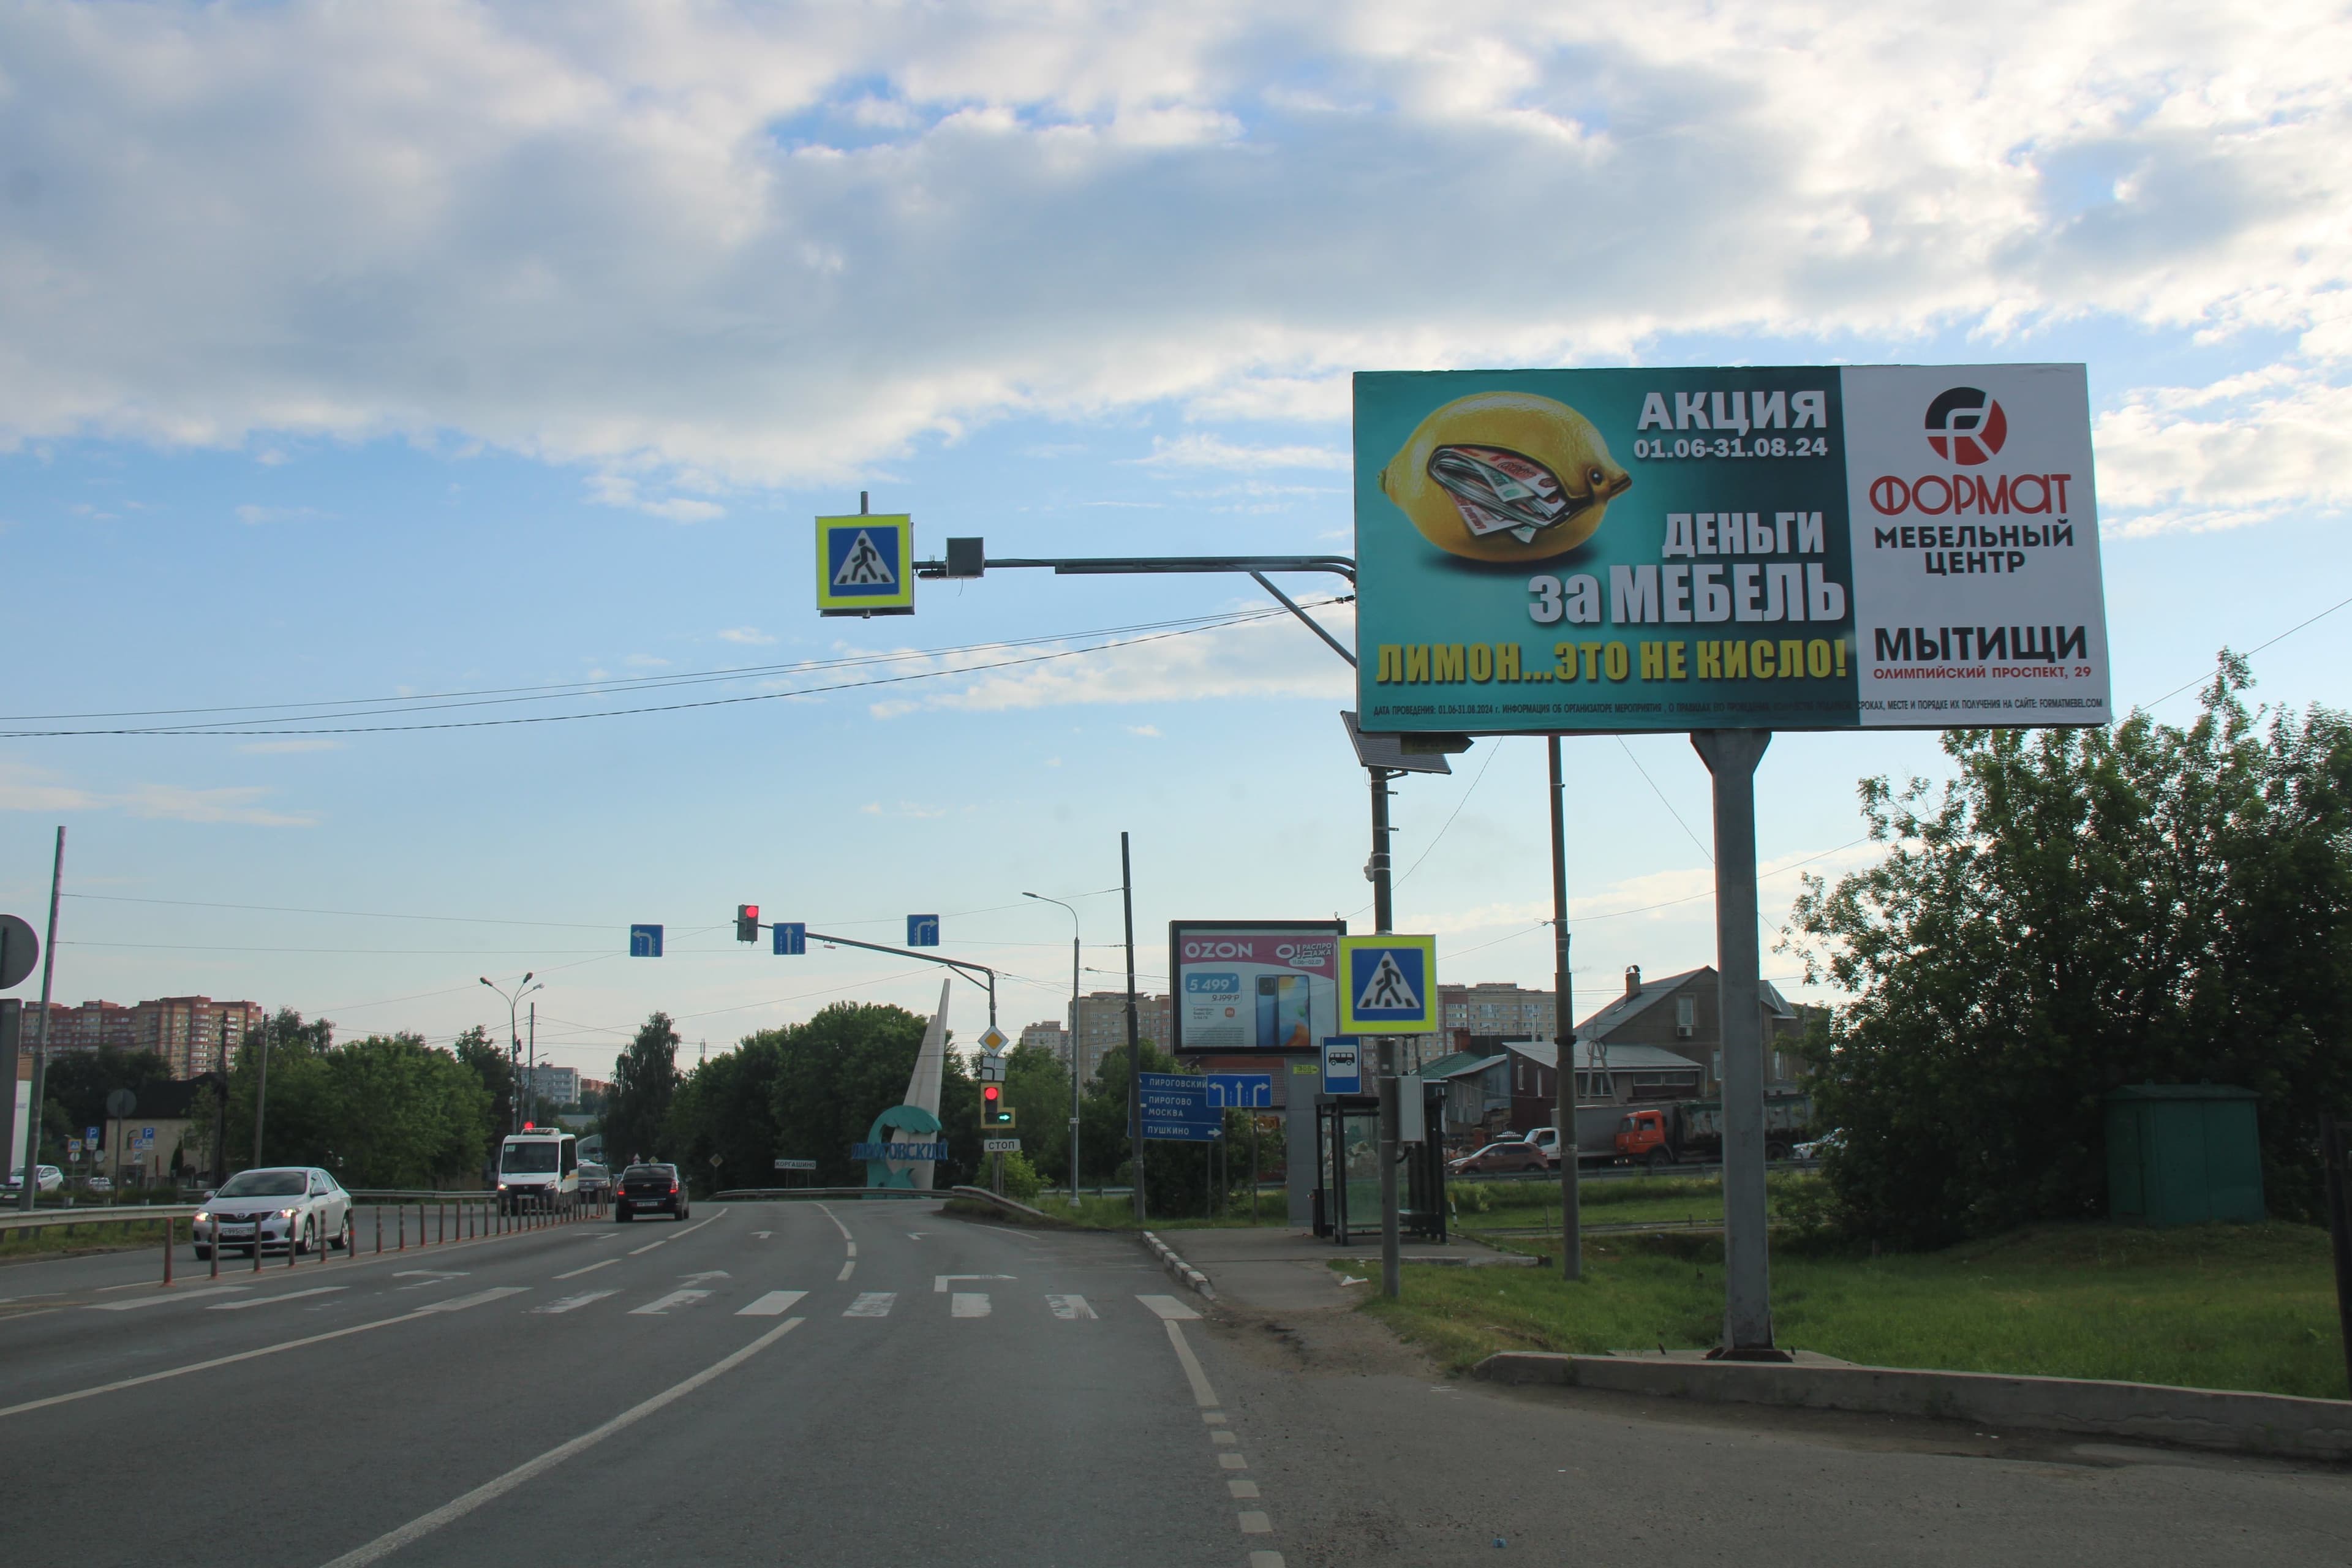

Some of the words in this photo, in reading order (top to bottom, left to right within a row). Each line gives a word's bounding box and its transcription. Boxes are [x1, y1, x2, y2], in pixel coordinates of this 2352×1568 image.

[1636, 390, 1828, 435] АКЦИЯ
[1634, 437, 1828, 458] 01.06-31.08.24
[1661, 512, 1825, 557] ДЕНЬГИ
[1874, 519, 2073, 549] МЕБЕЛЬНЫЙ
[1924, 551, 2026, 576] ЦЕНТР
[1609, 562, 1846, 623] МЕБЕЛЬ
[1874, 625, 2087, 663] МЫТИЩИ
[1640, 641, 1686, 680] НЕ
[1696, 638, 1847, 679] КИСЛО!
[1874, 666, 1986, 679] ОЛИМПИЙСКИЙ
[1992, 666, 2068, 680] ПРОСПЕКТ,
[2074, 666, 2091, 677] 29
[1374, 706, 1389, 716] ДАТА
[1392, 705, 1436, 716] ПРОВЕДЕНИЯ:
[1439, 704, 1493, 715] 01.06-31.08.2024
[1502, 704, 1550, 715] ИНФОРМАЦИЯ
[1552, 704, 1561, 713] ОБ
[1564, 703, 1612, 714] ОРГАНИЗАТОРЕ
[1887, 700, 1908, 710] МЕСТЕ
[1910, 700, 1915, 710] И
[1918, 699, 1948, 710] ПОРЯДКЕ
[1950, 699, 1959, 709] ИХ
[1962, 699, 2000, 709] ПОЛУЧЕНИЯ
[2003, 699, 2012, 709] НА
[1185, 942, 1253, 958] OZON
[1149, 1096, 1192, 1106] ПИРОГОВО
[1148, 1108, 1183, 1117] МОСКВА
[1147, 1126, 1189, 1135] ПУШКИНО
[989, 1141, 1015, 1150] СТОП
